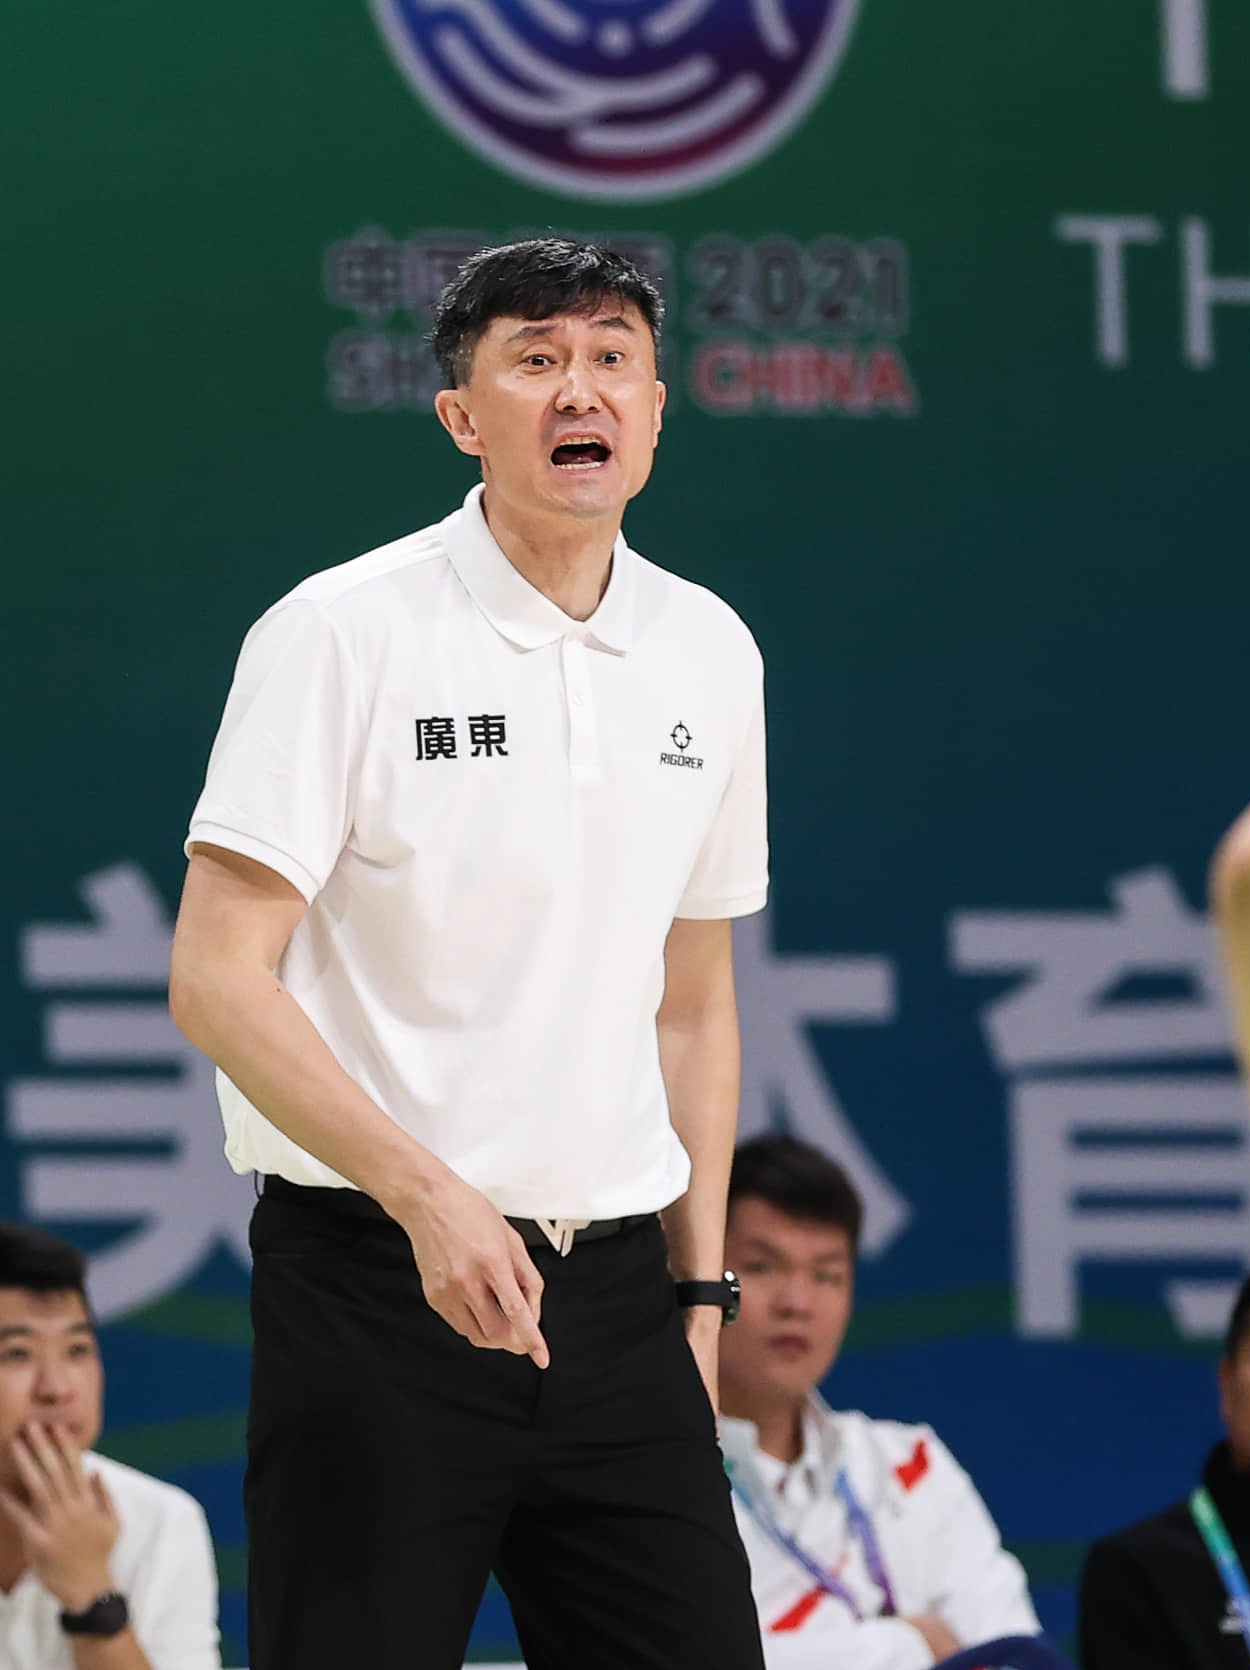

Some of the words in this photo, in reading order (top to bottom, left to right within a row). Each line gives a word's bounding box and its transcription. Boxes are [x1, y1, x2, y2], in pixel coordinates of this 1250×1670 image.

[692, 233, 914, 333] 2021
[693, 338, 914, 413] CHINA
[415, 713, 508, 761] 廣東
[660, 752, 704, 771] RIGORER
